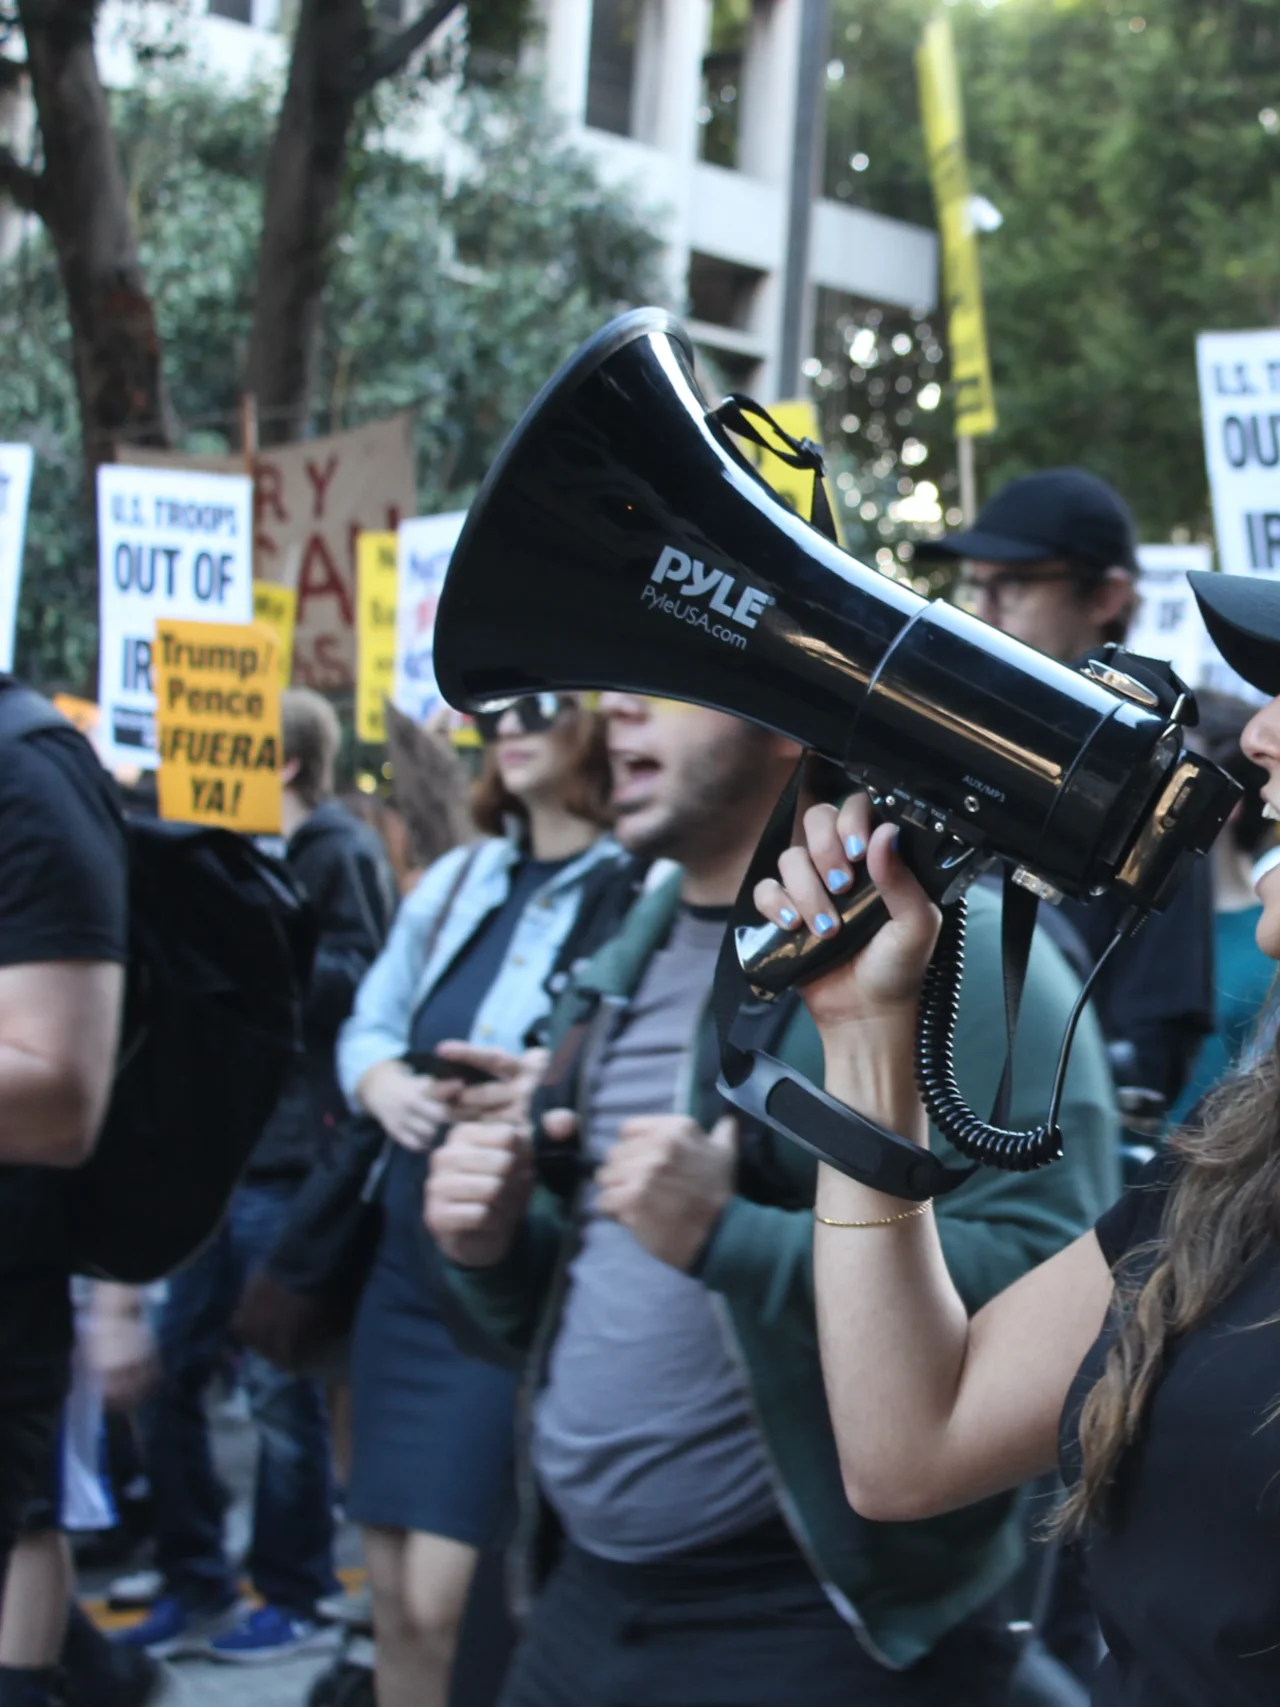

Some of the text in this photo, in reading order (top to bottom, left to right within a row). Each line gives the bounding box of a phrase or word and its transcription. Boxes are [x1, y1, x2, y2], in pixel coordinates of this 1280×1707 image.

[155, 498, 239, 537] TROOPS
[113, 541, 180, 599] OUT
[192, 550, 234, 606] OF
[651, 545, 770, 630] PYLE
[640, 584, 748, 650] PyleUSA.com
[166, 676, 264, 719] Pence
[190, 777, 244, 817] YA!
[963, 775, 1006, 802] AUX/MP3
